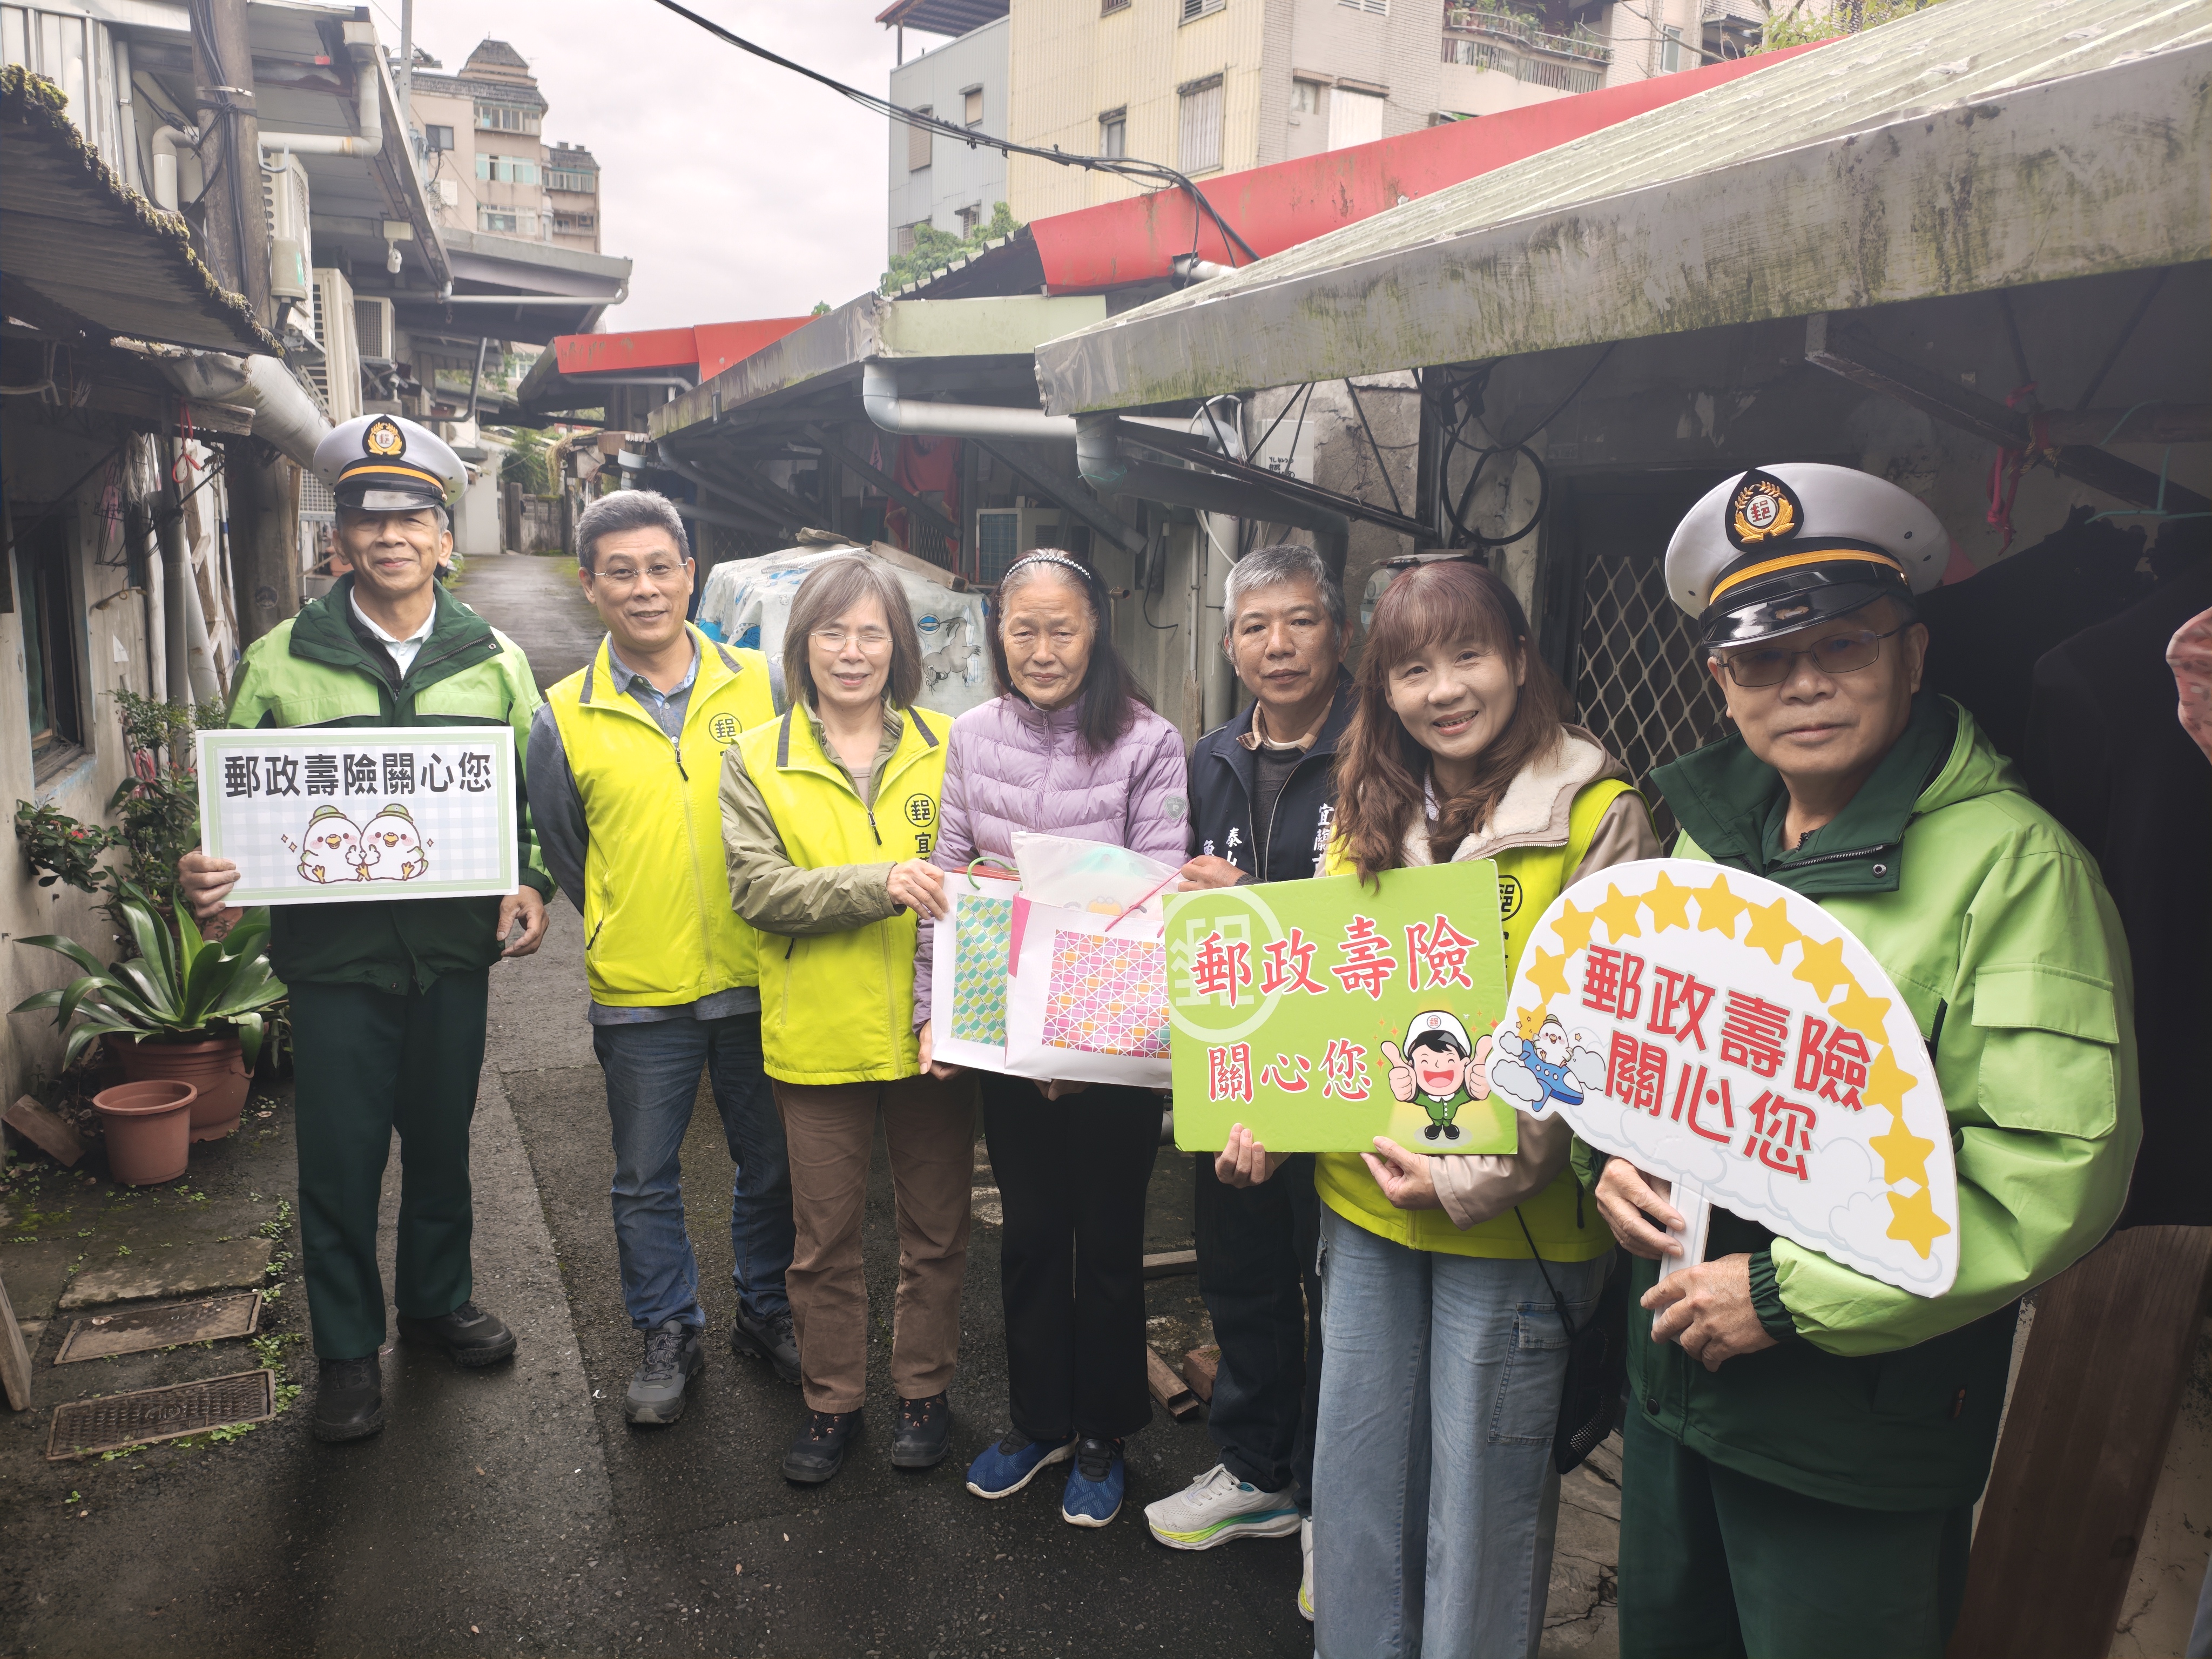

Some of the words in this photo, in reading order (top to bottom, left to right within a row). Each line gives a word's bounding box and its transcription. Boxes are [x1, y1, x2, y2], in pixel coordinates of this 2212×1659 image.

[224, 752, 492, 799] 郵政壽險關心您
[915, 832, 932, 862] 宜
[1190, 913, 1479, 1009] 郵政壽險
[1580, 942, 1872, 1112] 郵政壽險
[1208, 1037, 1373, 1103] 關心您
[1603, 1029, 1819, 1182] 關心您
